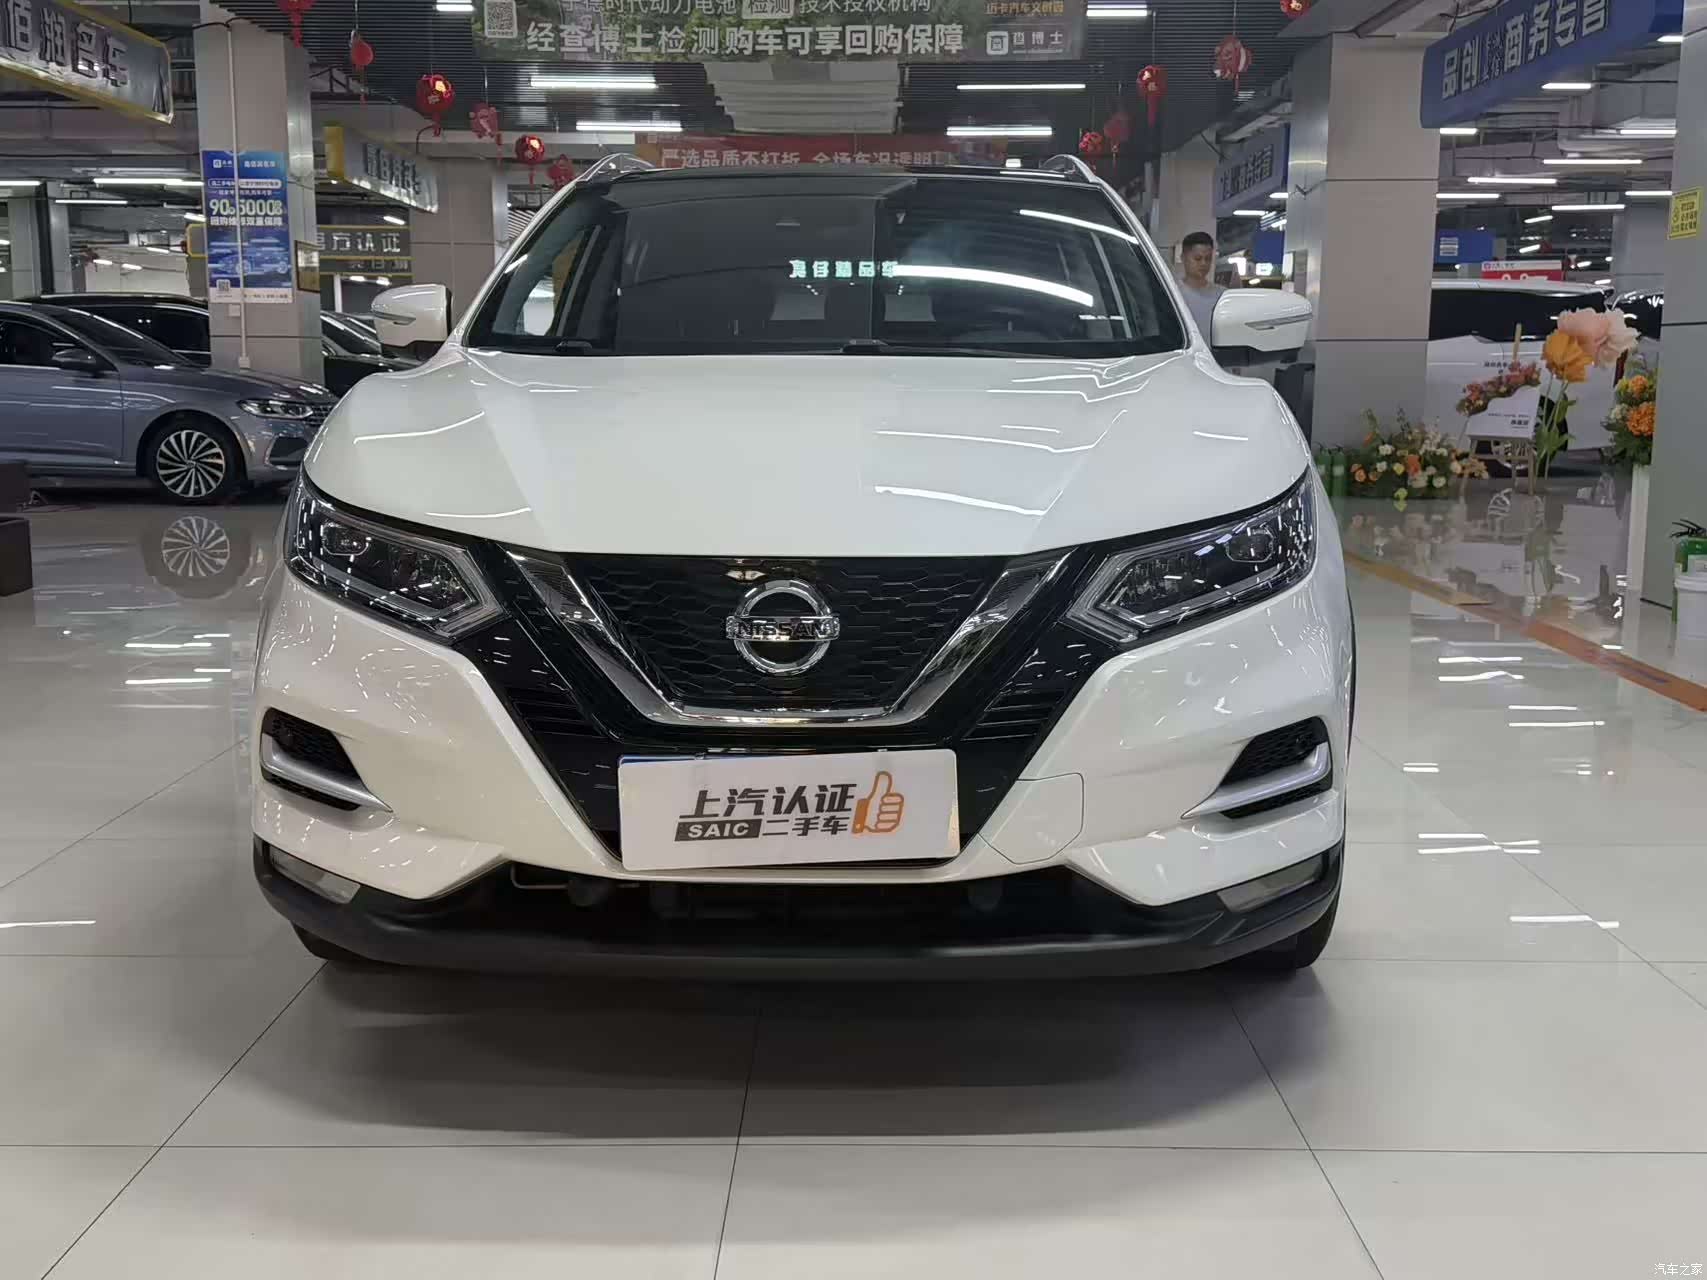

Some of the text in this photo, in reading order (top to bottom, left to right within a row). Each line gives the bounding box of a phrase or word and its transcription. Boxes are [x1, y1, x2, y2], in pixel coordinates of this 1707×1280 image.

[526, 22, 964, 55] 经查博士检测购车可享回购保障
[738, 622, 824, 638] NISSAN
[679, 783, 858, 819] 上汽认证
[687, 815, 850, 839] SAIC 二手车
